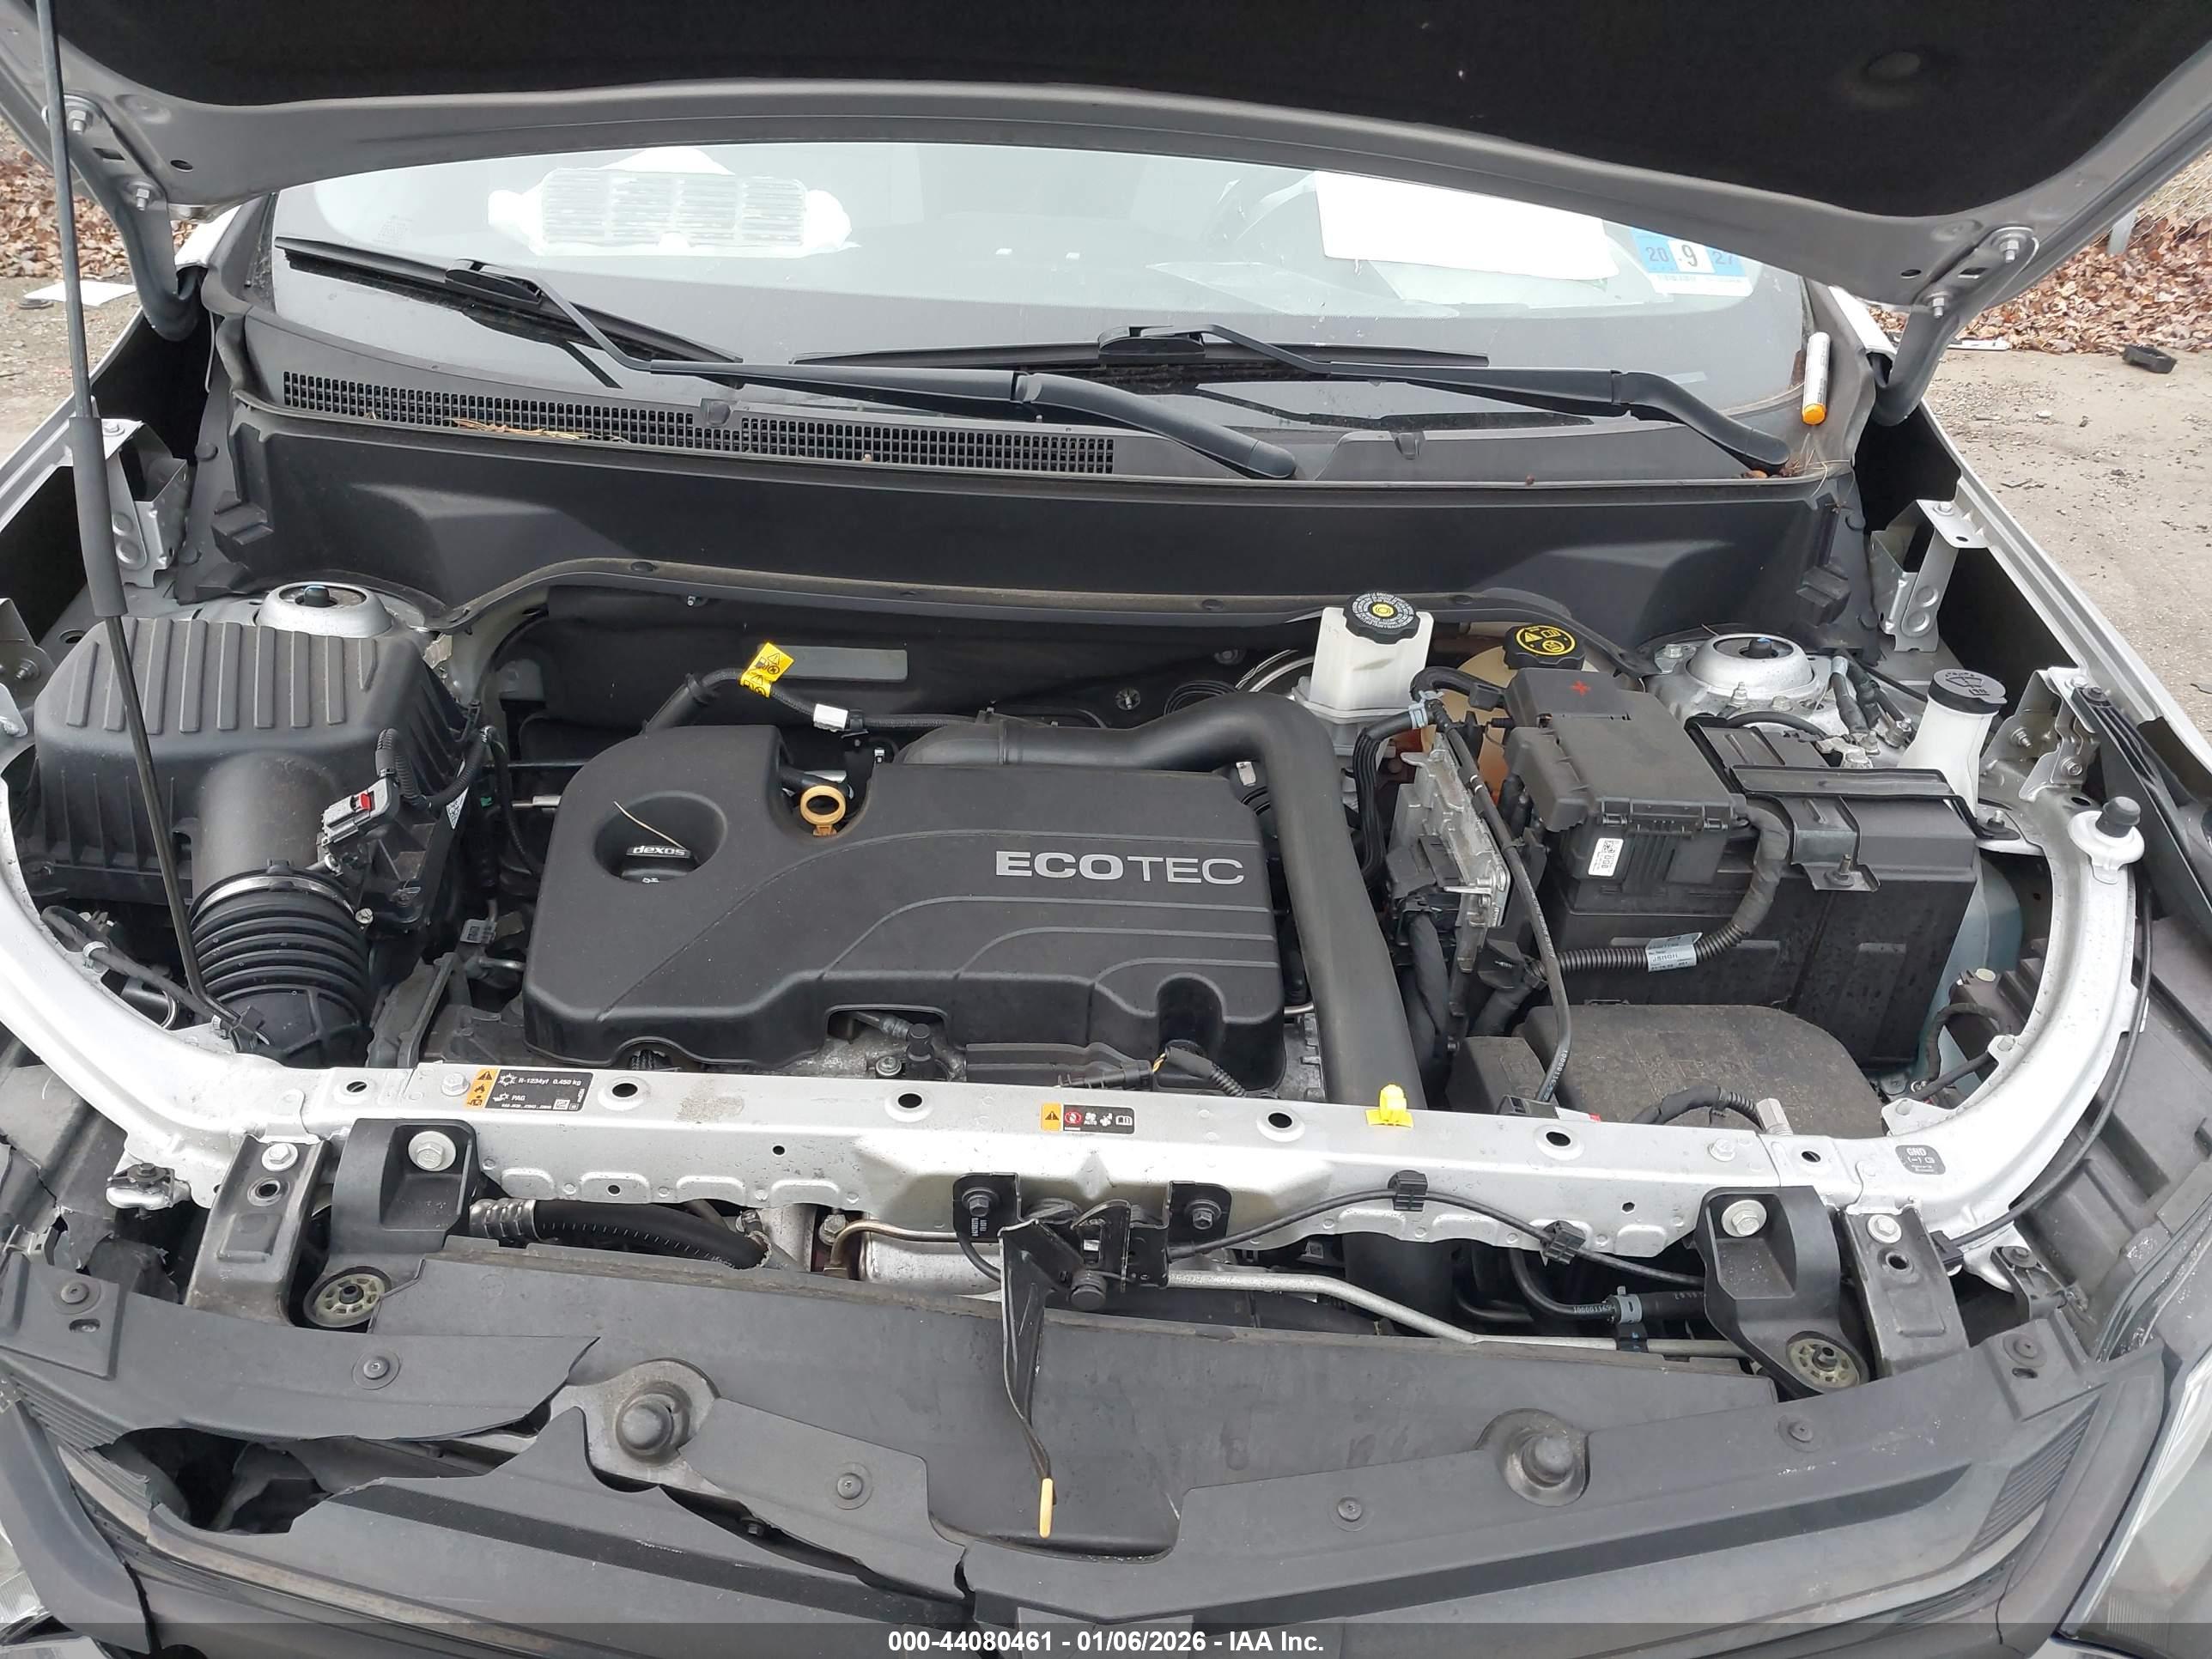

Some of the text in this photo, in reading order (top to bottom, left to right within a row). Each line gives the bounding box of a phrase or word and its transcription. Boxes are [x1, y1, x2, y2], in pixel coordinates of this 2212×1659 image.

[1645, 244, 1735, 268] 20 9 27
[632, 845, 685, 856] dexos
[995, 850, 1244, 884] ECOTEC
[1906, 1147, 1927, 1157] GND
